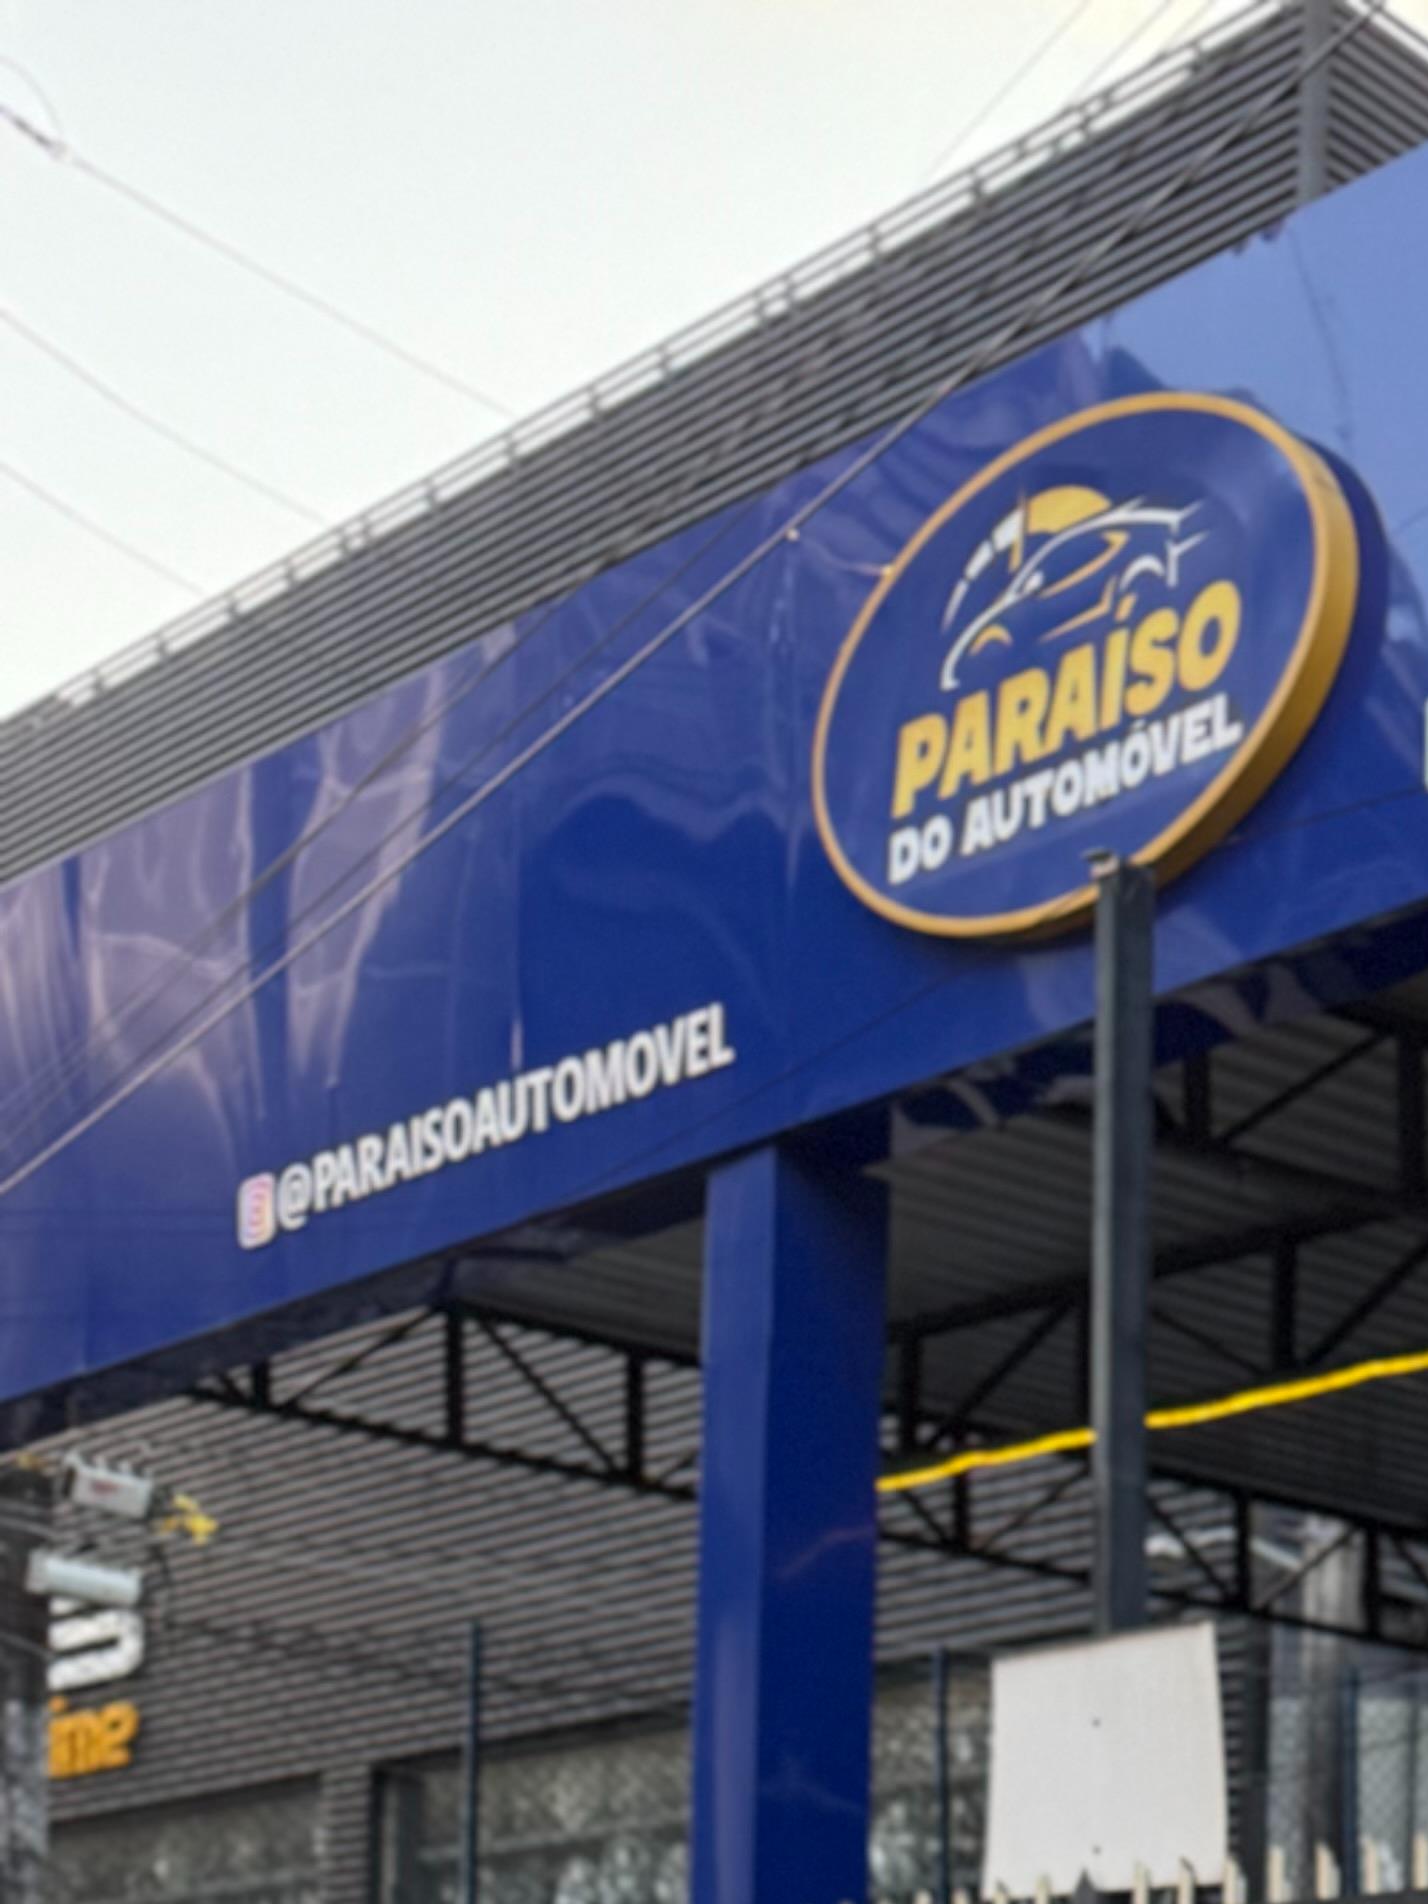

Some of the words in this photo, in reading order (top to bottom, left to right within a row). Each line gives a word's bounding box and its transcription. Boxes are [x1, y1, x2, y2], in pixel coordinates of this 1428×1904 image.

[888, 815, 952, 885] DO
[960, 691, 1243, 855] AUTOMÓVEL
[891, 579, 1242, 818] PARAÍSO
[276, 1001, 735, 1230] @PARAISOAUTOMOVEL
